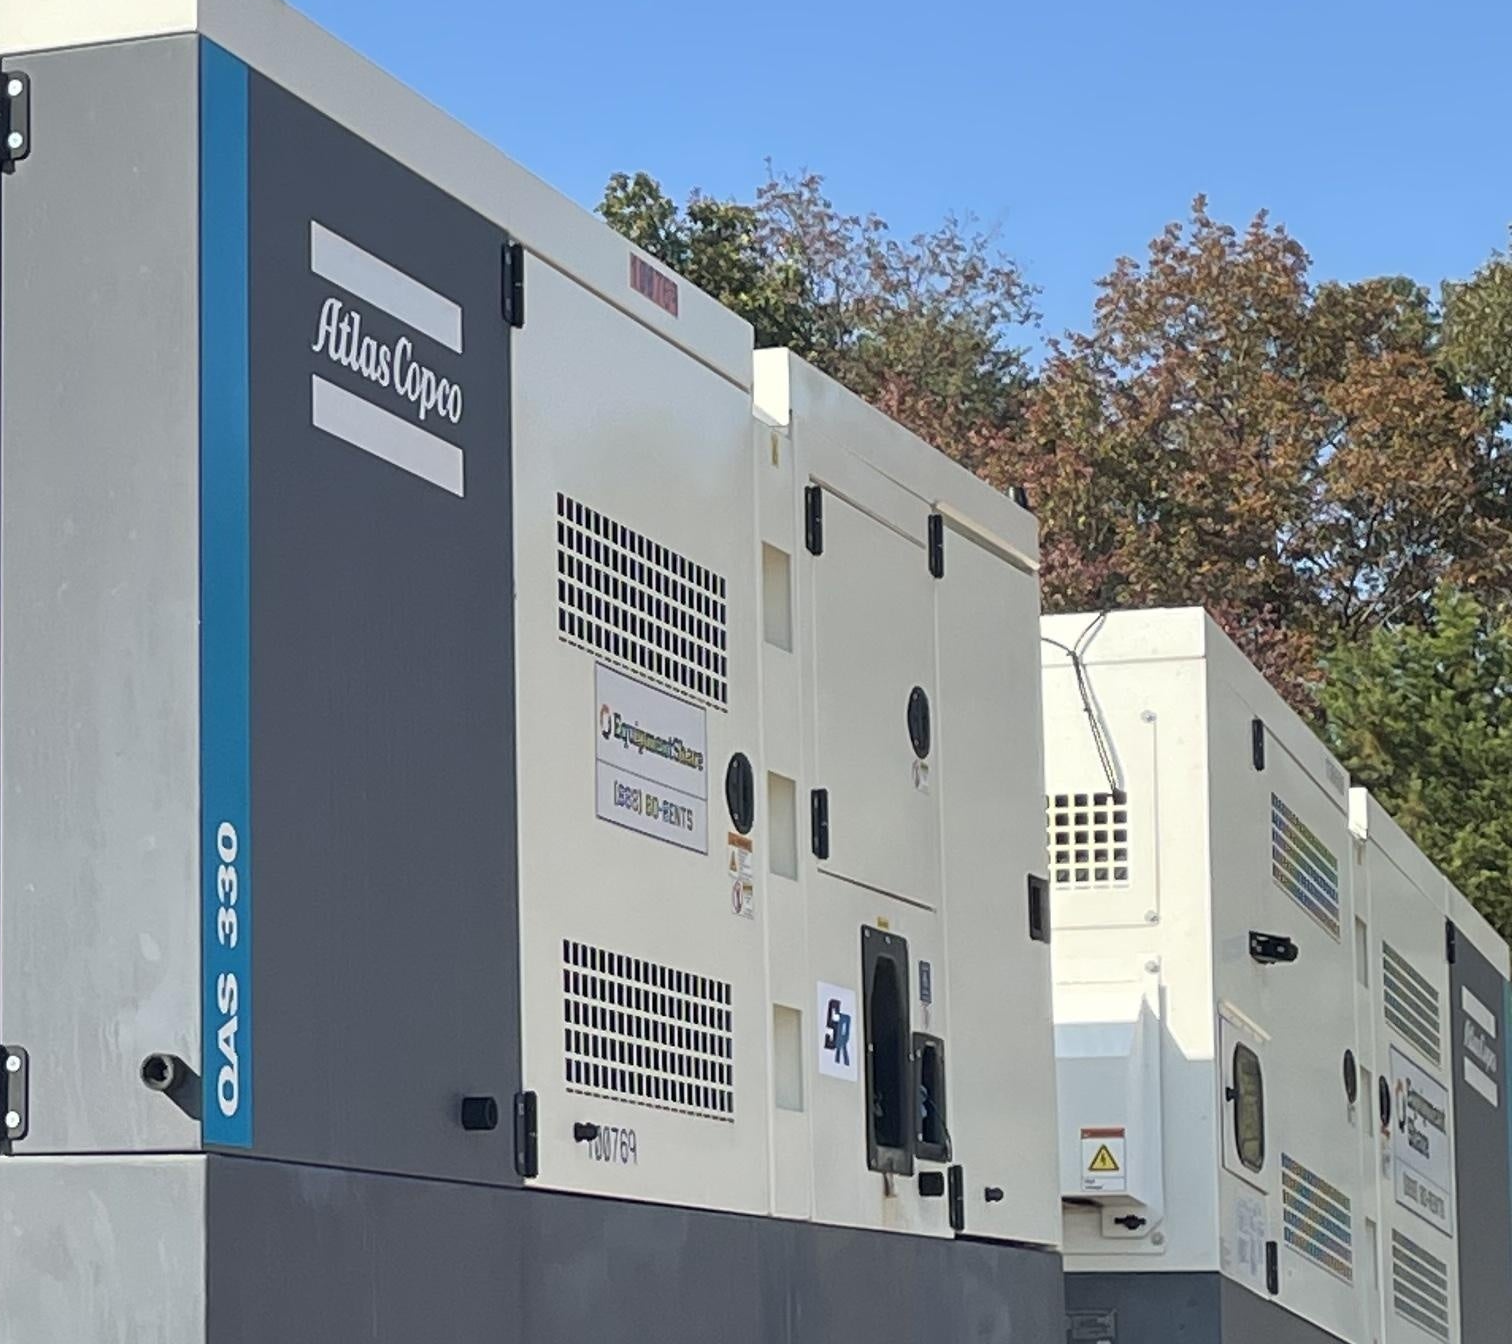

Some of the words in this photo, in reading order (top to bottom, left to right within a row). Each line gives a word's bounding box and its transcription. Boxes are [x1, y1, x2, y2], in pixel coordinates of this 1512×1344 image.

[311, 297, 391, 387] Atlas
[393, 336, 462, 423] Copco
[217, 821, 239, 949] 330
[217, 972, 239, 1117] QAS
